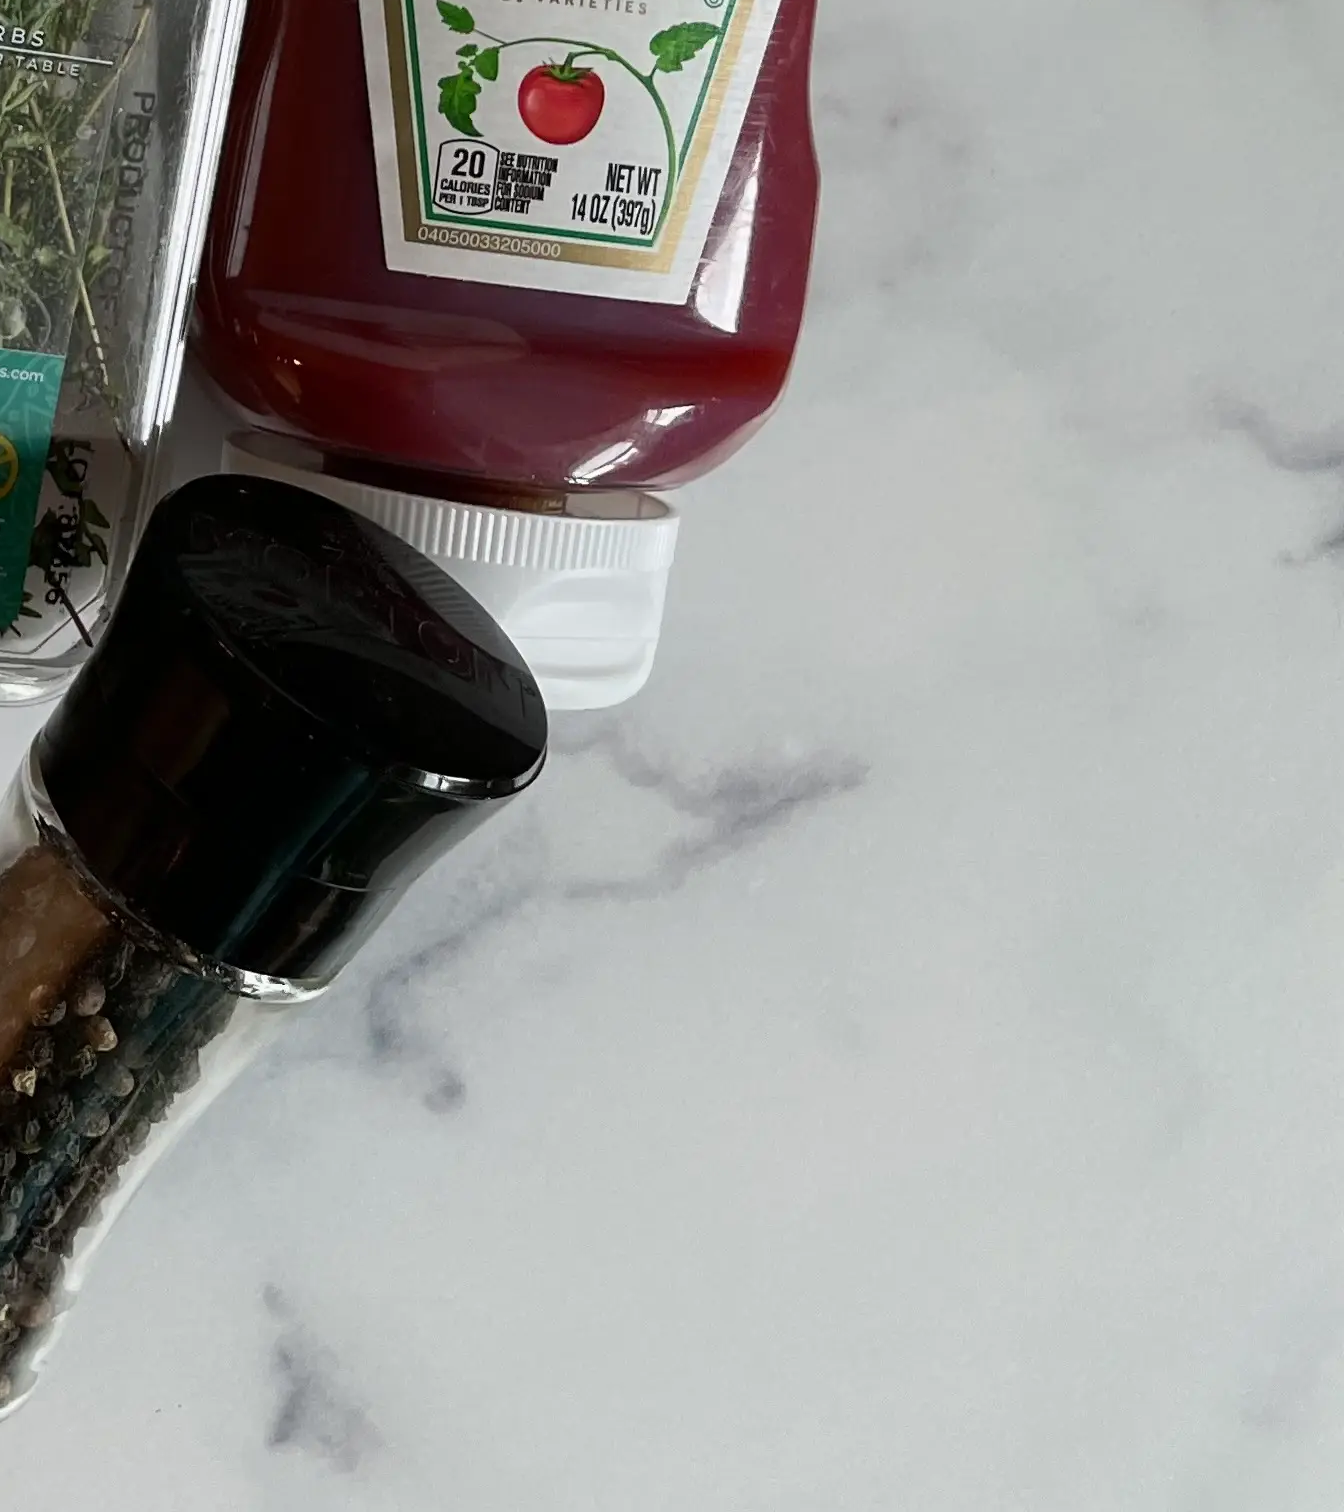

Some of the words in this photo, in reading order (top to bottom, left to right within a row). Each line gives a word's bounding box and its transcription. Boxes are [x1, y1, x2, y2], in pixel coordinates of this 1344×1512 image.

[15, 55, 82, 78] TABLE
[451, 148, 485, 178] 20
[440, 179, 490, 195] CALORIES
[499, 167, 551, 187] INFORMATION
[605, 163, 635, 192] NET
[637, 167, 661, 196] WT
[494, 198, 530, 214] CONTENT
[571, 194, 585, 221] 14
[590, 194, 611, 224] OZ
[612, 198, 656, 235] (397g)
[418, 226, 561, 258] 04050033205000
